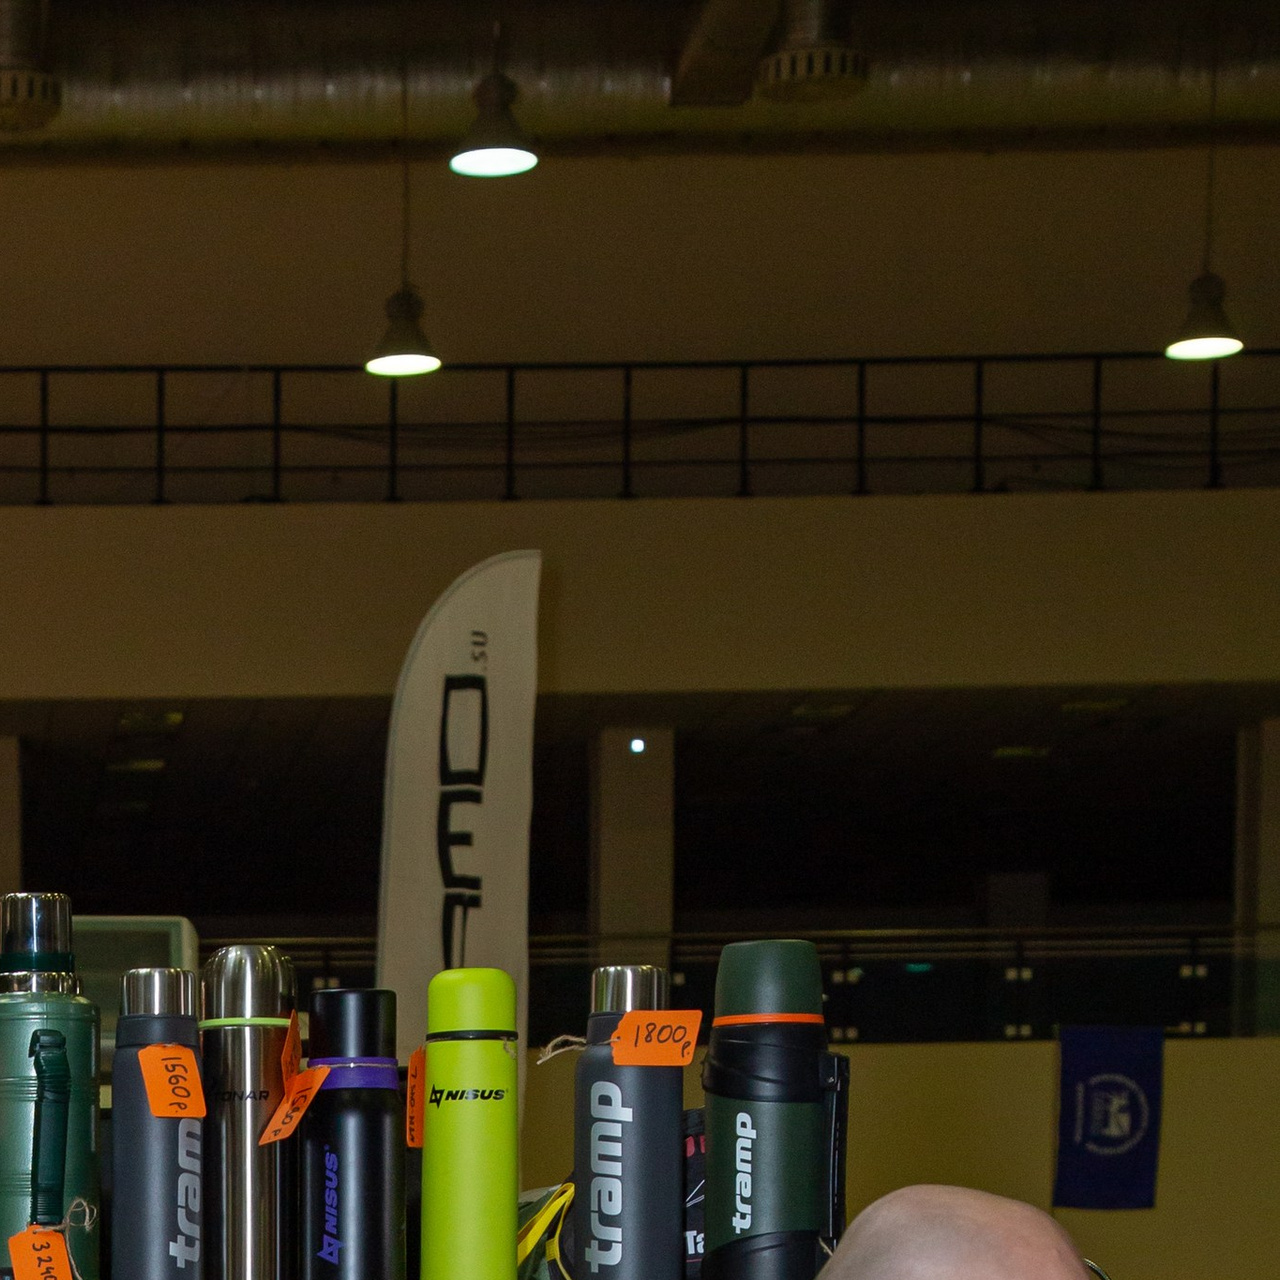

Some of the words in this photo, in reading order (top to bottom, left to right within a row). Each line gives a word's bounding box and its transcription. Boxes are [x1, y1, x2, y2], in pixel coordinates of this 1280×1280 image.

[633, 1023, 687, 1048] 1800
[445, 1088, 505, 1101] NISUS
[323, 1152, 339, 1234] NISUS
[584, 1080, 633, 1273] tramp
[731, 1111, 757, 1234] tramp
